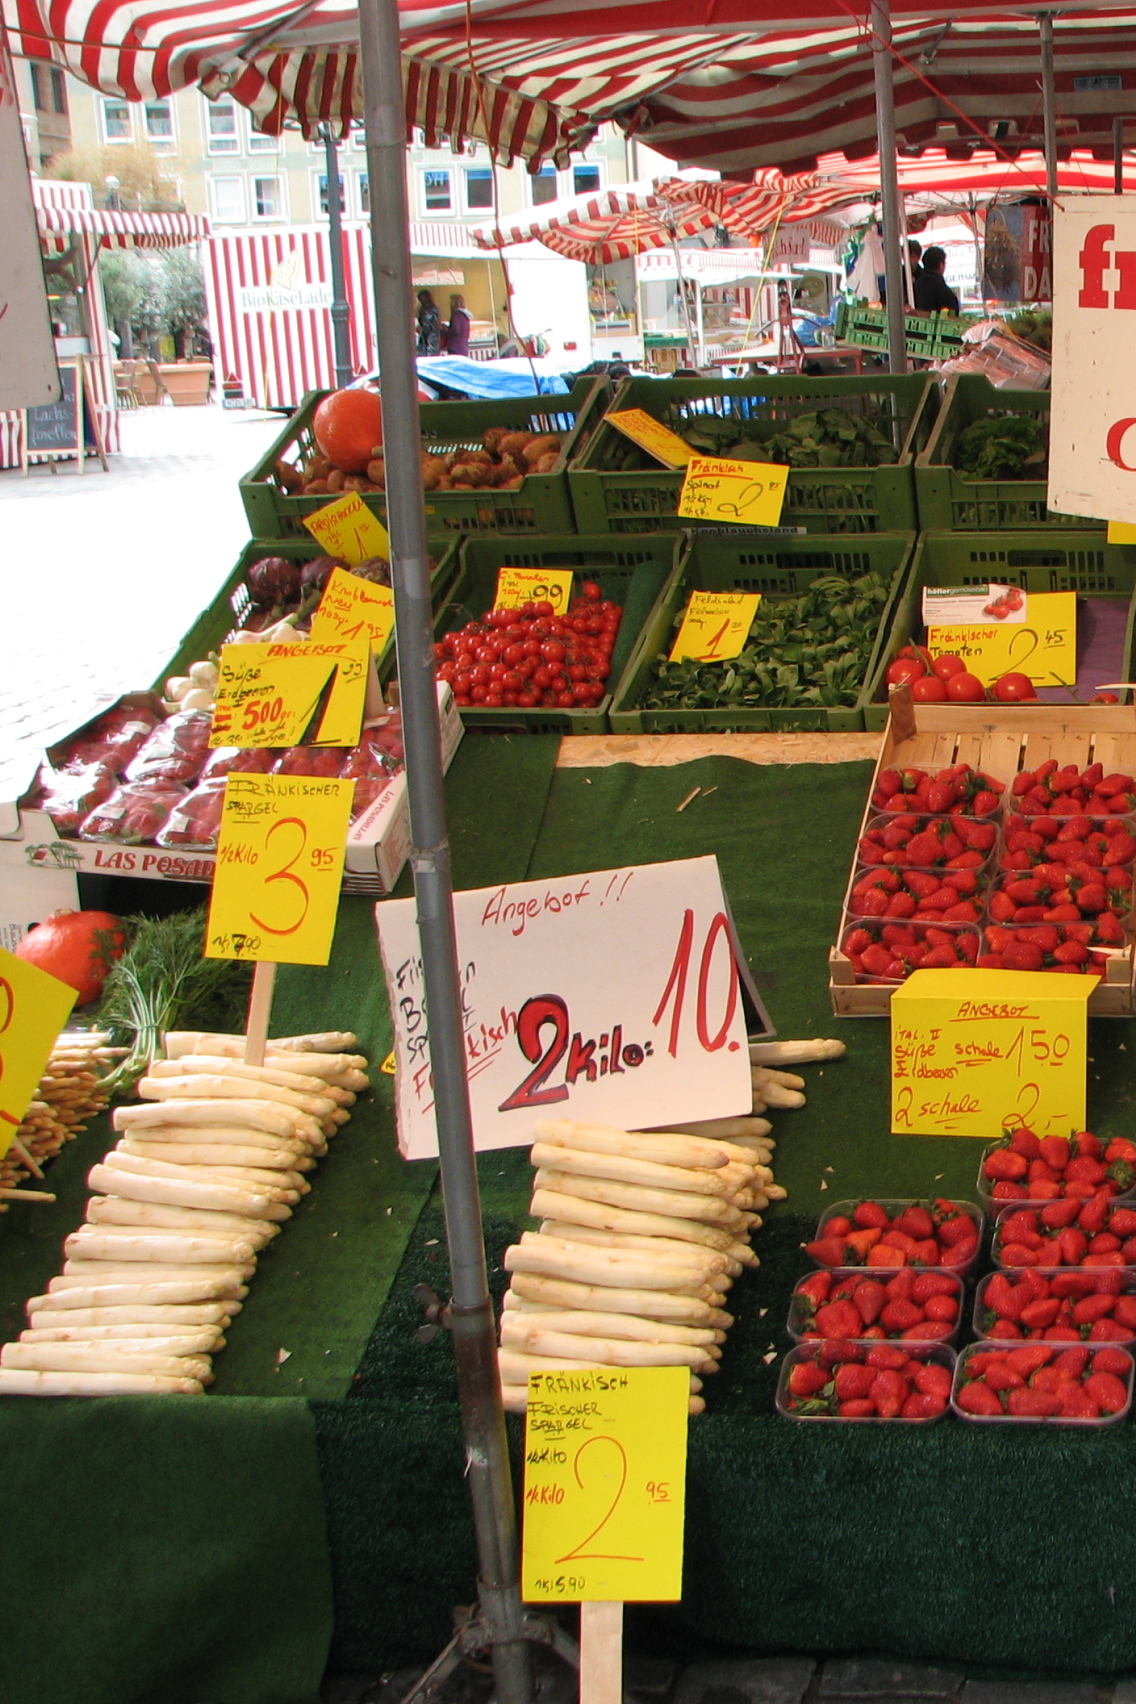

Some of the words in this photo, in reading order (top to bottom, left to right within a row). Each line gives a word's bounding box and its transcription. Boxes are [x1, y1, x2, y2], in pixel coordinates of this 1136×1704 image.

[242, 287, 334, 308] BioKäseLade
[717, 482, 764, 517] 2
[266, 644, 347, 658] ANGEBOT
[694, 618, 731, 660] 1
[988, 628, 1046, 681] 2
[1045, 629, 1067, 645] 45
[222, 663, 262, 689] Süße
[294, 663, 342, 747] 1
[228, 777, 340, 797] FRÄNKISCHER
[226, 801, 279, 814] SPARGEL
[94, 849, 138, 870] LAS
[142, 854, 217, 878] POSAD
[249, 816, 310, 936] 3
[310, 847, 338, 867] 95
[481, 879, 592, 937] Angebot
[957, 1001, 1030, 1017] ANGEBOT
[498, 993, 571, 1111] 2
[895, 1086, 914, 1127] 2
[918, 1092, 983, 1116] schale
[530, 1371, 630, 1394] FRÄNKISCH
[527, 1401, 603, 1416] FRISCHER
[530, 1418, 594, 1432] SPARGEL
[554, 1436, 645, 1564] 2
[645, 1481, 673, 1502] 95
